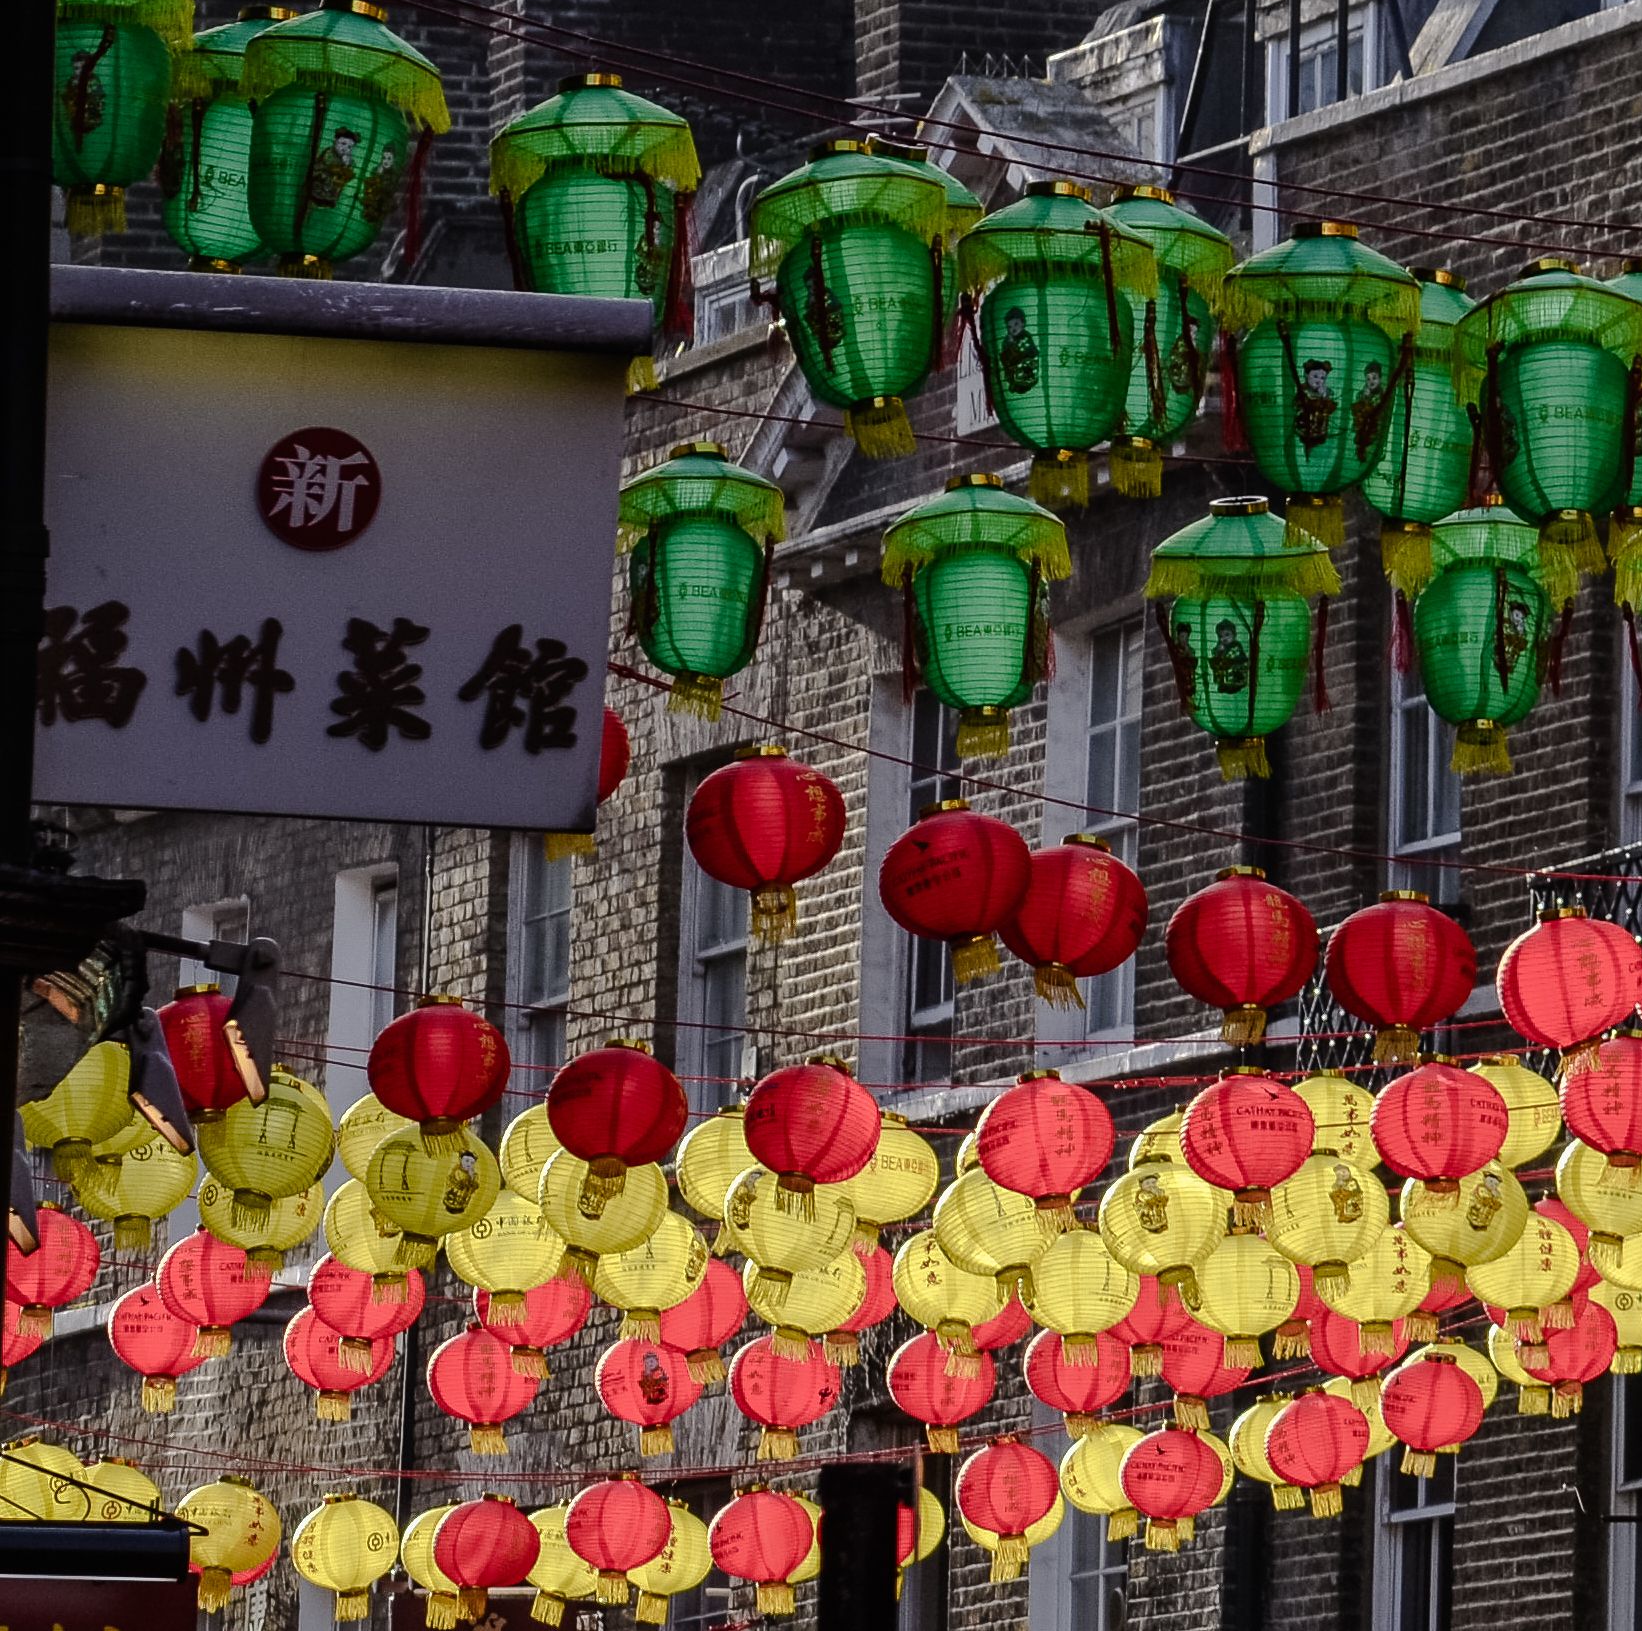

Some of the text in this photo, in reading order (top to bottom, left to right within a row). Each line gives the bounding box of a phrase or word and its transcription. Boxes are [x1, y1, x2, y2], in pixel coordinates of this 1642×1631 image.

[547, 240, 576, 256] BEA
[268, 443, 372, 532] 新
[957, 623, 982, 639] BEA
[37, 600, 590, 756] 福州菜館
[881, 1154, 906, 1171] BEA
